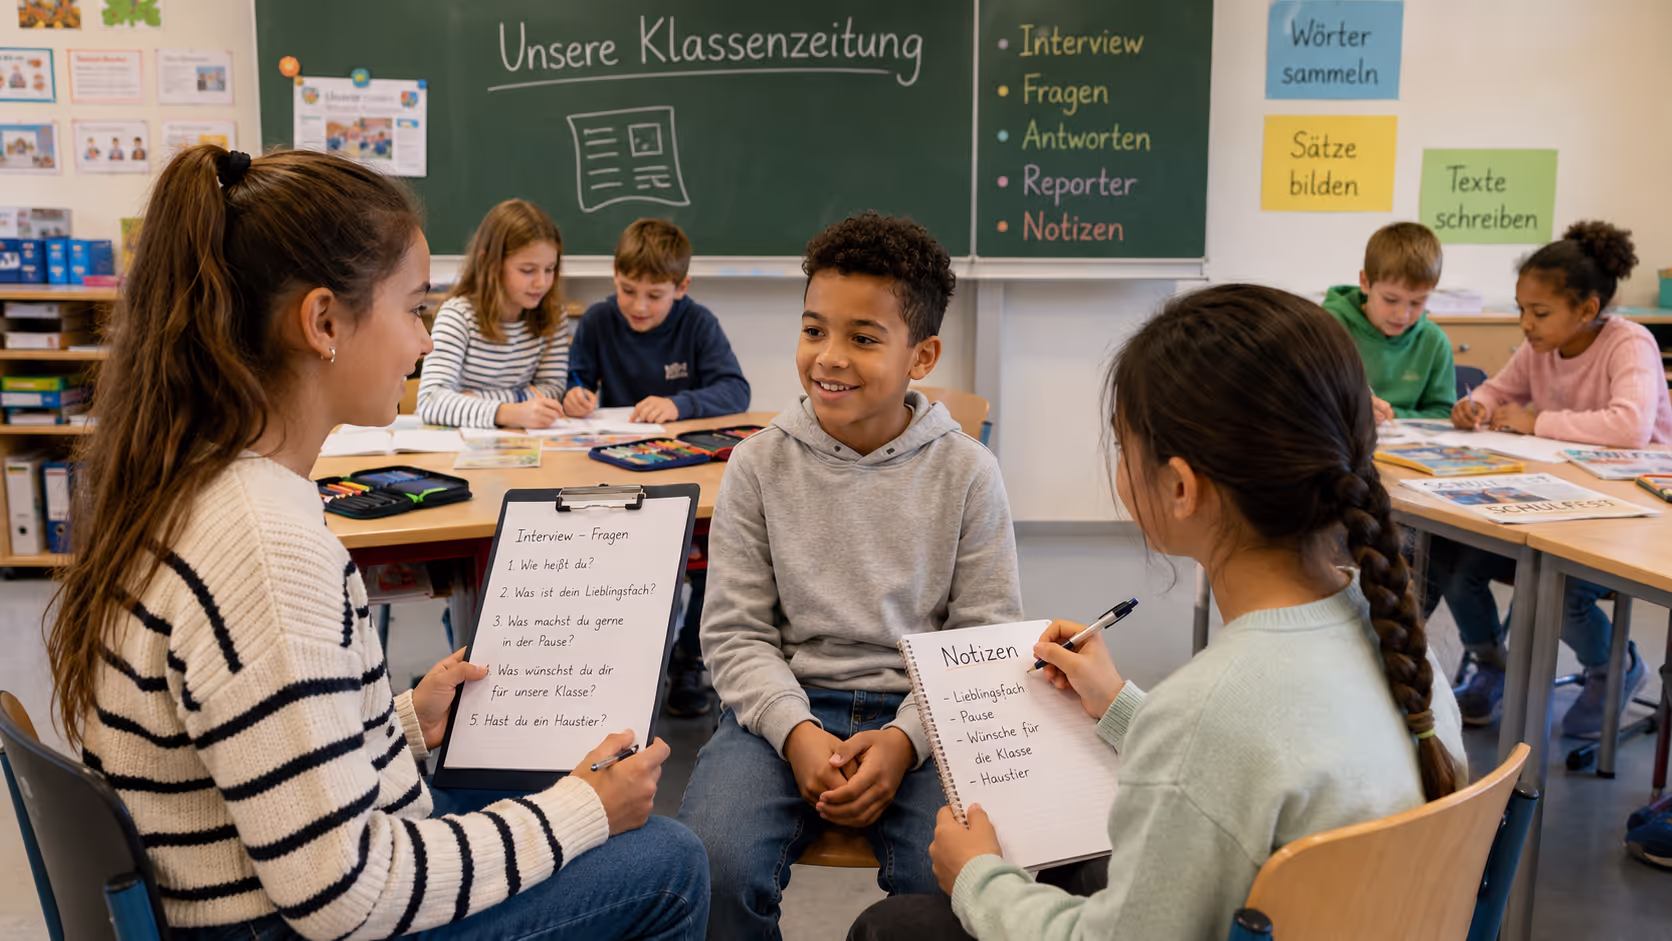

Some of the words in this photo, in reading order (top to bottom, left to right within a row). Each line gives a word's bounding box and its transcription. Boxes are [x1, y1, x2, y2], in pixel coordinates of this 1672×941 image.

[1018, 24, 1145, 57] Interview
[1291, 18, 1373, 48] Wörter
[498, 21, 619, 72] Unsere
[639, 14, 924, 87] Klassenzeitung
[1281, 58, 1379, 86] sammeln
[1023, 72, 1109, 117] Fragen
[1021, 118, 1151, 152] Antworten
[1290, 131, 1357, 160] Sätze
[1023, 164, 1138, 207] Reporter
[1289, 169, 1359, 197] bilden
[1446, 164, 1507, 195] Texte
[1023, 210, 1124, 242] Notizen
[1434, 204, 1538, 231] schreiben
[1485, 499, 1616, 514] SCHULFEST
[515, 528, 574, 544] Interview
[591, 527, 629, 546] Fragen
[507, 559, 516, 571] 1.
[520, 559, 538, 571] Wie
[543, 558, 570, 572] heißt
[574, 557, 595, 570] du?
[499, 586, 509, 599] 2.
[515, 587, 535, 599] Was
[540, 586, 554, 598] ist
[559, 585, 580, 598] dein
[585, 583, 656, 602] Lieblingsfach?
[492, 615, 503, 628] 3.
[508, 615, 528, 627] Was
[534, 614, 571, 627] machst
[576, 614, 590, 627] du
[594, 616, 624, 631] gerne
[502, 637, 511, 648] in
[516, 636, 534, 648] der
[538, 634, 575, 648] Pause?
[941, 643, 1019, 669] Notizen
[498, 664, 519, 676] Was
[524, 663, 574, 676] wünschst
[579, 663, 593, 676] du
[598, 664, 614, 676] dir
[490, 686, 509, 702] für
[514, 687, 549, 698] unsere
[554, 684, 596, 698] Klasse?
[953, 682, 1025, 705] Lieblingsfach
[469, 714, 479, 727] 5.
[484, 714, 509, 727] Hast
[514, 714, 528, 727] du
[533, 716, 549, 727] ein
[554, 713, 607, 728] Haustier?
[960, 710, 995, 725] Pause
[966, 727, 1017, 744] Wünsche
[1022, 722, 1040, 740] für
[974, 752, 992, 765] die
[995, 745, 1033, 761] Klasse
[980, 767, 1030, 787] Haustier
